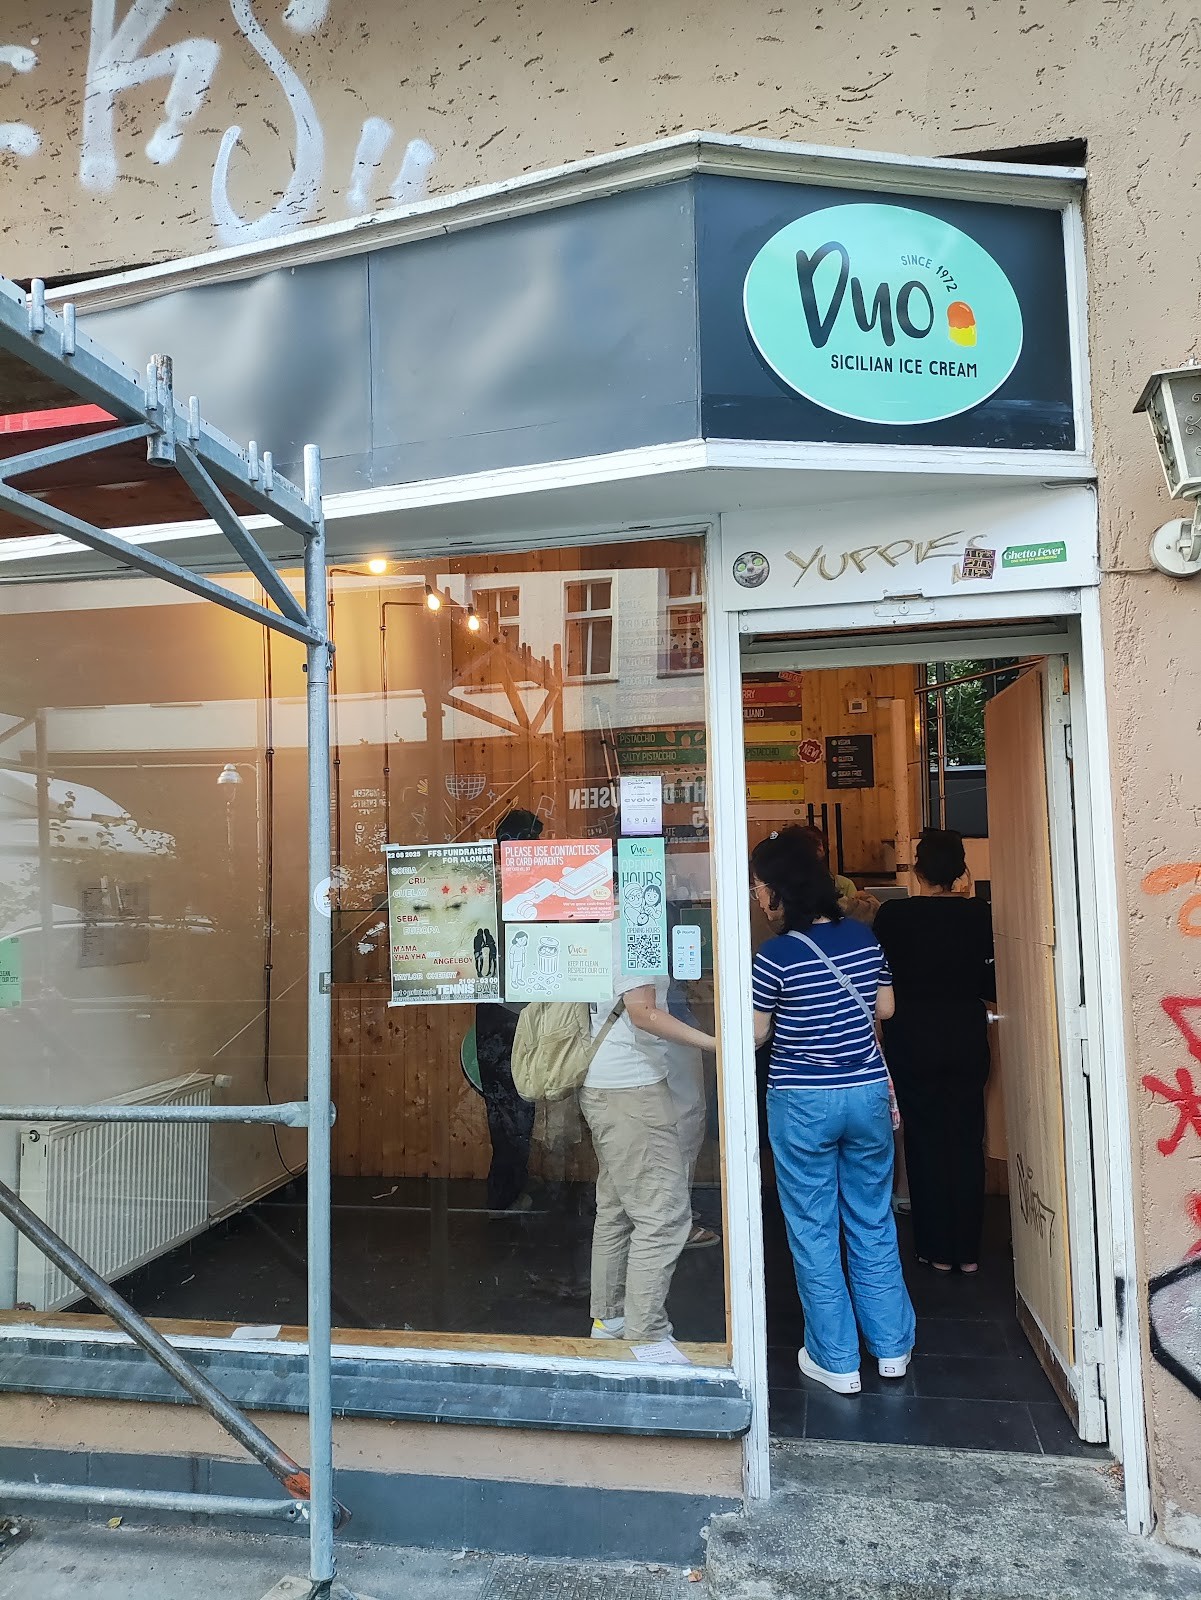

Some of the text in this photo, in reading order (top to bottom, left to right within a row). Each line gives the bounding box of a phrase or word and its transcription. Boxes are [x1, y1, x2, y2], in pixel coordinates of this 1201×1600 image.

[901, 254, 958, 293] SINCE 1972
[796, 241, 934, 349] Duo
[831, 354, 978, 378] SICILIAN ICE CREAM
[1003, 549, 1036, 561] Ghetto
[1037, 547, 1063, 557] Fever
[620, 733, 655, 744] PISTACCHIO
[622, 751, 676, 762] SALTY PISTACCHIO
[801, 744, 820, 759] NEW!
[428, 846, 492, 858] FFS FUNDRAISER
[505, 844, 600, 857] PLEASE USE CONTACTLESS
[630, 844, 647, 855] Duo
[460, 855, 492, 863] ALONAS
[505, 856, 564, 866] OR CARD PAYMENTS
[622, 858, 661, 871] OPENING
[622, 872, 662, 888] HOURS
[403, 926, 440, 935] EUROPA
[568, 944, 583, 954] Duo
[394, 954, 410, 962] YHA
[434, 957, 473, 965] ANGELBOY
[394, 971, 458, 981] TAYLOR CHERRY
[436, 984, 475, 995] TENNIS
[476, 983, 498, 994] BAR
